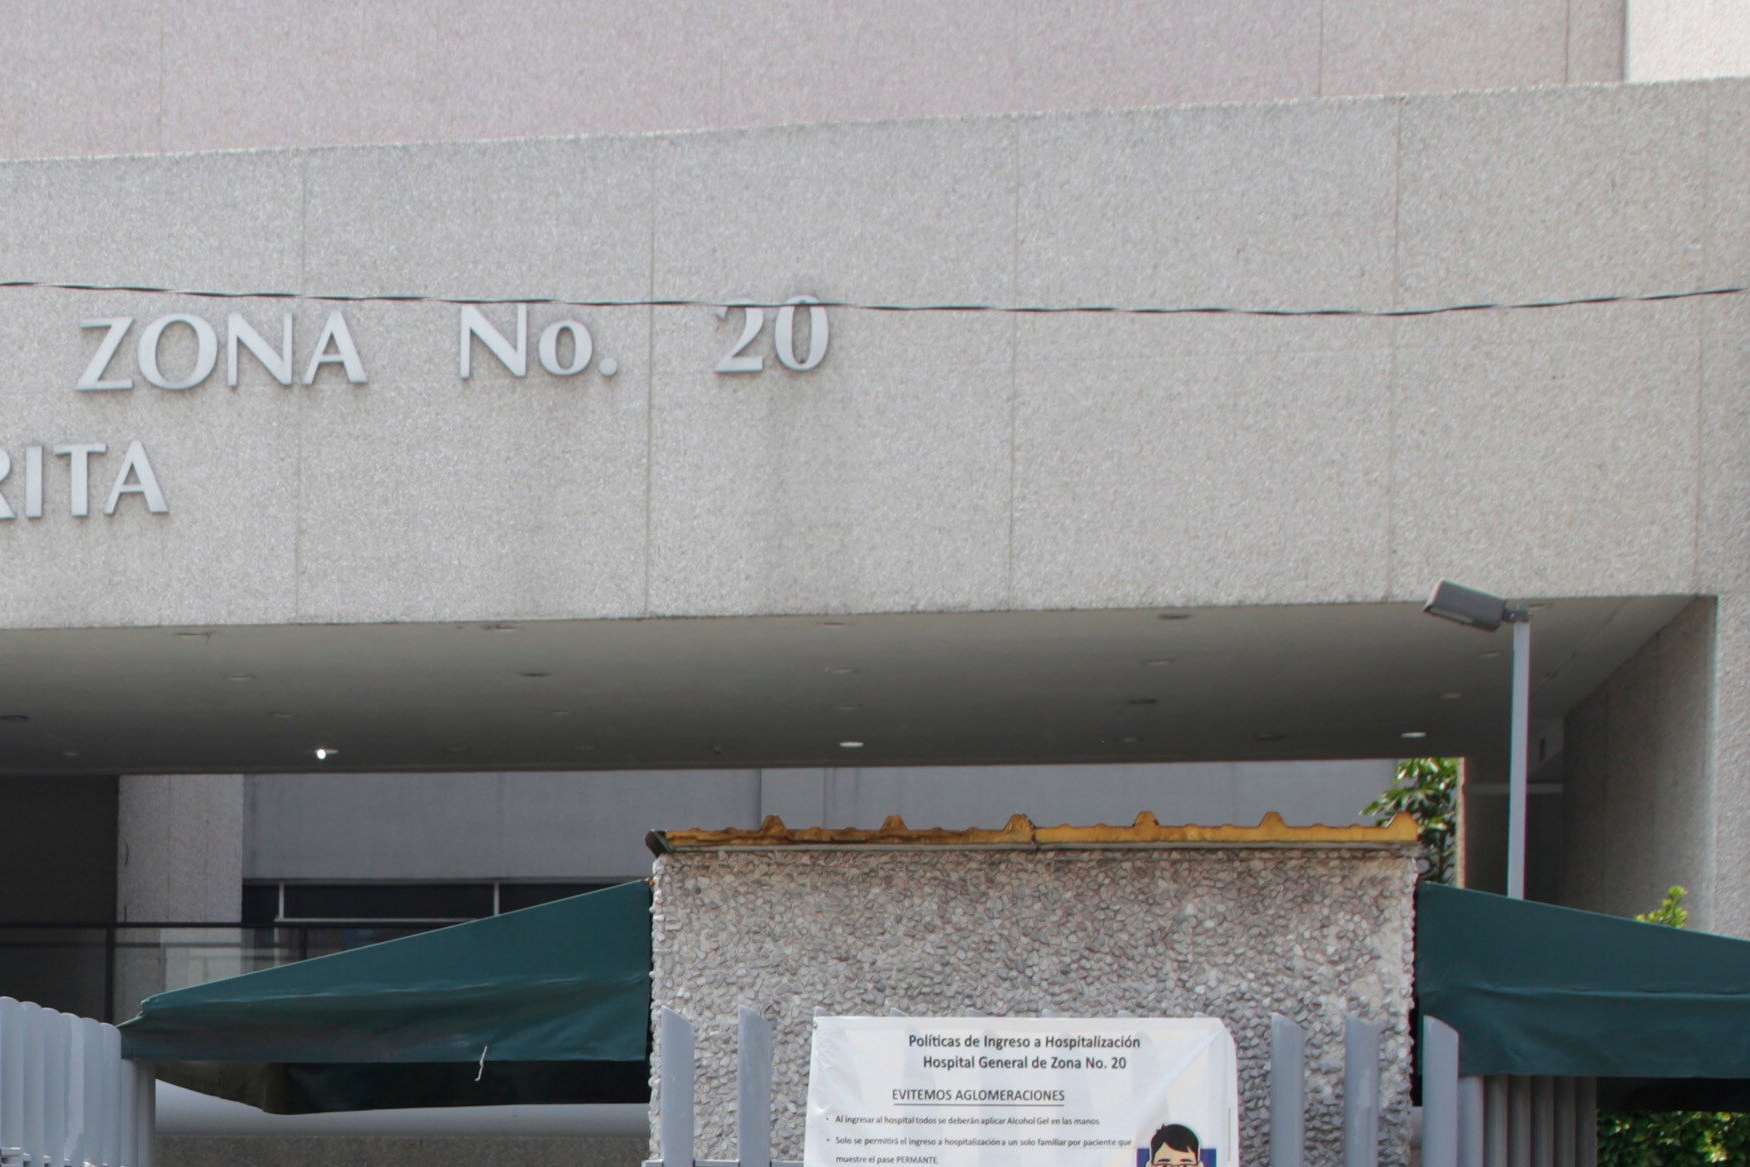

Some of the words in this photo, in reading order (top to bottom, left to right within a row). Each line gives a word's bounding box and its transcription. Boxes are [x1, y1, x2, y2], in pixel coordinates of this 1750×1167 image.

[75, 309, 369, 393] ZONA
[460, 304, 618, 379] No.
[715, 294, 831, 375] 20
[908, 1034, 961, 1047] Políticas
[964, 1034, 980, 1047] de
[983, 1035, 1030, 1050] Ingreso
[1033, 1038, 1041, 1048] a
[1045, 1035, 1140, 1050] Hospitalización
[923, 1055, 975, 1070] Hospital
[978, 1055, 1028, 1068] General
[1031, 1055, 1047, 1068] de
[1050, 1056, 1081, 1068] Zona
[1085, 1056, 1107, 1069] No.
[1111, 1056, 1126, 1069] 20
[892, 1089, 952, 1100] EVITEMOS
[954, 1089, 1065, 1101] AGLOMERACIONES
